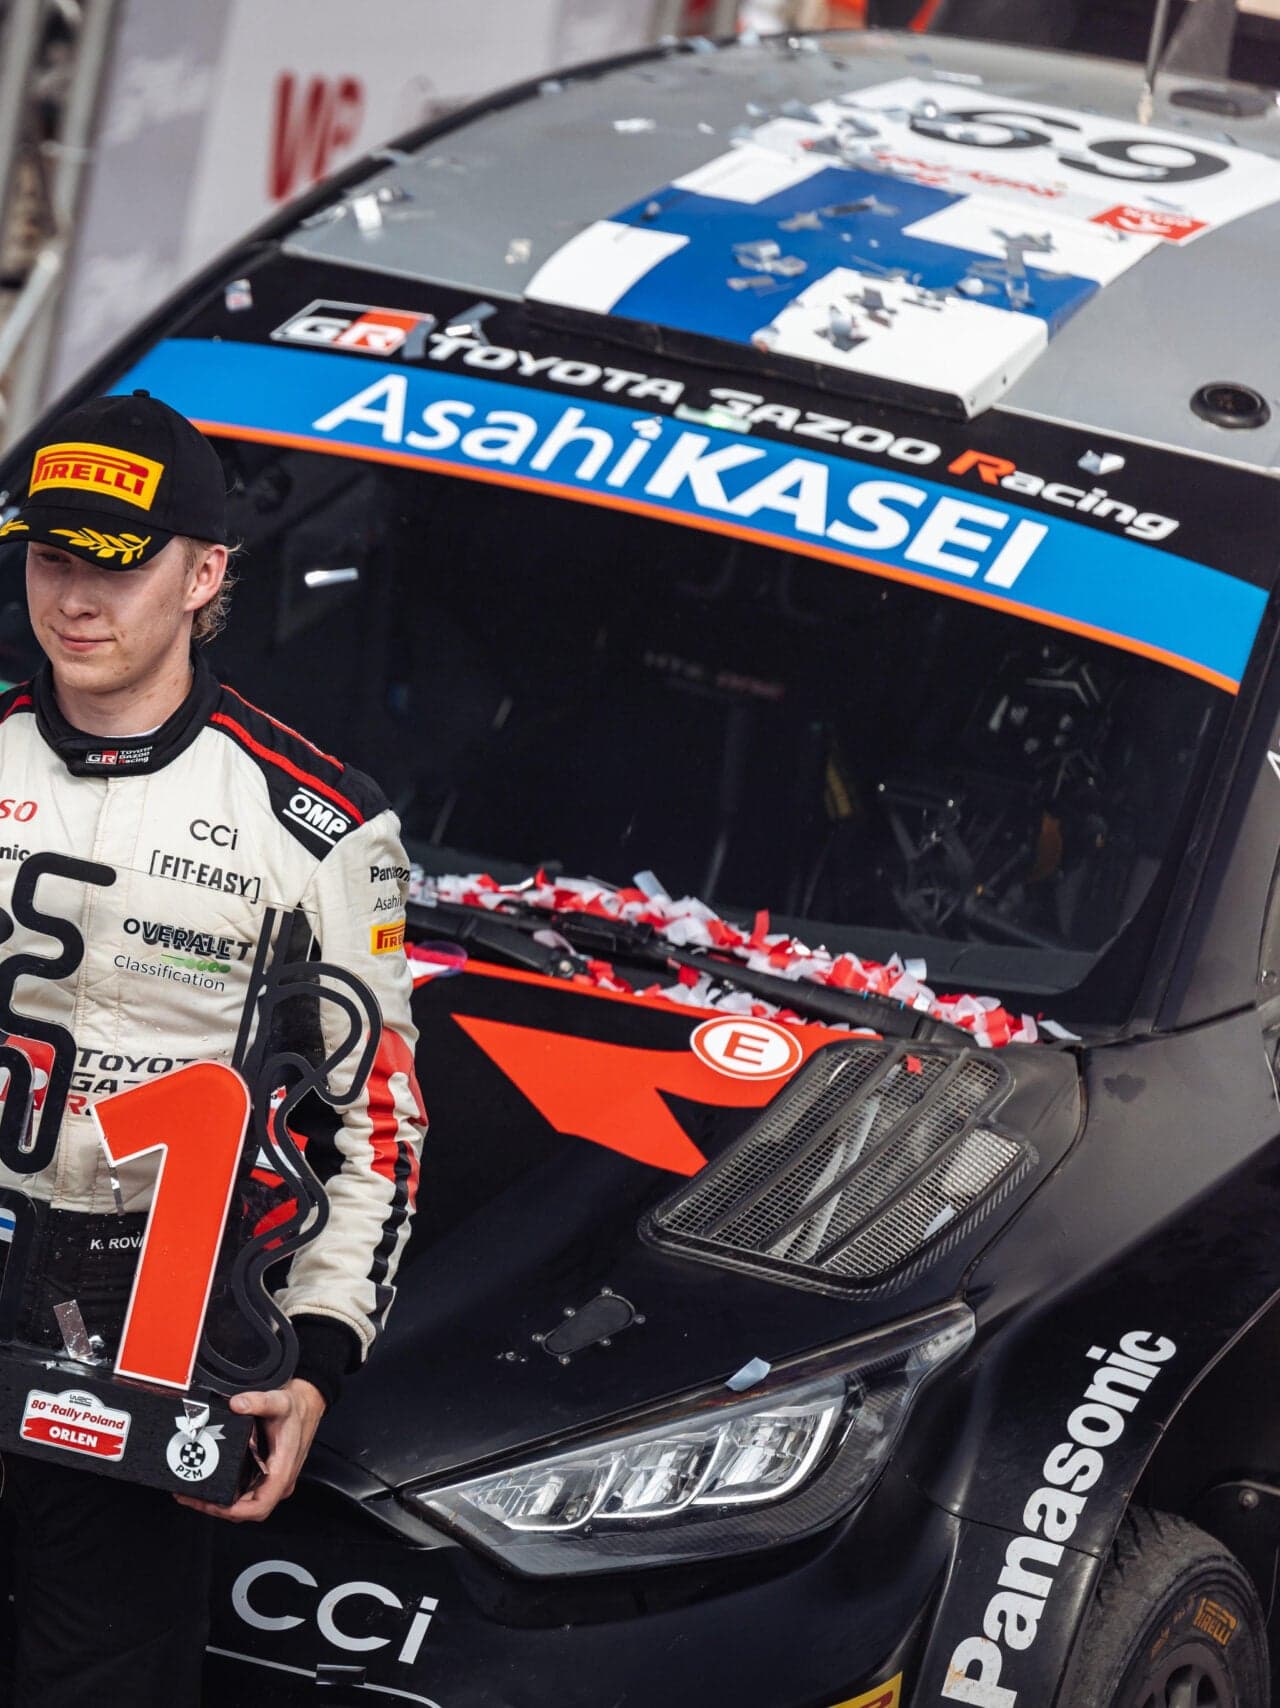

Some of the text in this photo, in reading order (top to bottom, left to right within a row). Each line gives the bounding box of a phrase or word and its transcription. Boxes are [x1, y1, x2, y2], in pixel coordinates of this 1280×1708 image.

[281, 313, 1181, 542] GR TOYOTA GAZOO Racing
[32, 450, 150, 497] PIRELLI
[188, 818, 240, 851] CCi
[288, 793, 349, 837] OMP
[113, 953, 226, 993] Classification
[720, 1029, 767, 1067] E
[91, 1059, 252, 1391] 1
[48, 1425, 99, 1449] ORLEN
[50, 1403, 82, 1422] Rally
[82, 1411, 126, 1430] Poland
[173, 1463, 205, 1481] PZM
[940, 1329, 1178, 1708] Panasonic
[231, 1559, 440, 1665] CCi
[1192, 1597, 1239, 1647] PIRELLI
